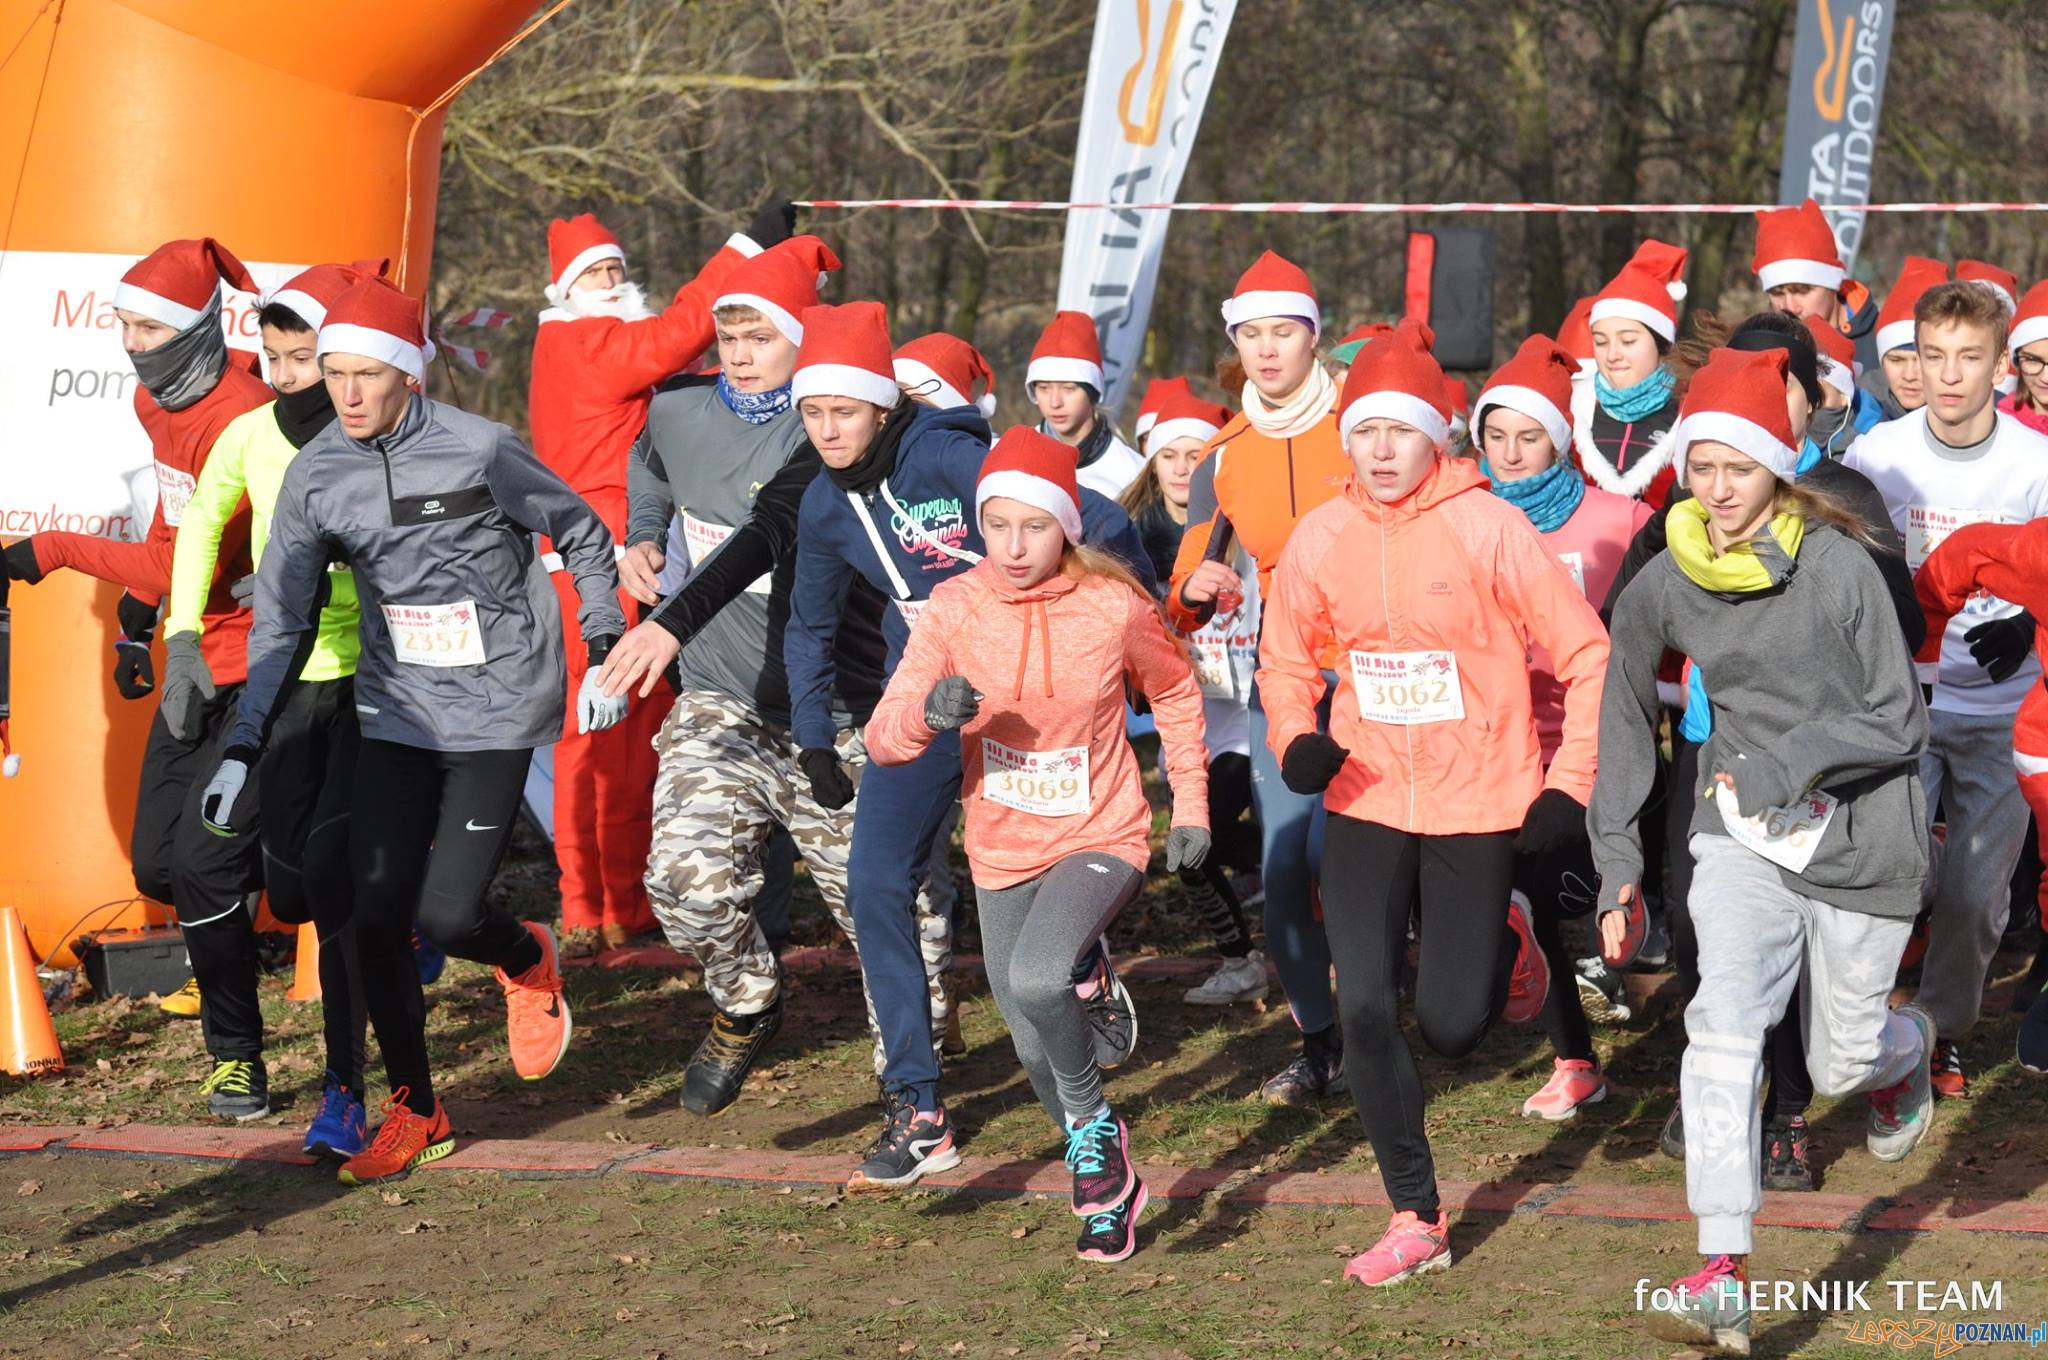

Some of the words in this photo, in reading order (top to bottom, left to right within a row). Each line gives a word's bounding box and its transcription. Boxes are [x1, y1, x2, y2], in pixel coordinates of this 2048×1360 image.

[402, 627, 470, 651] 2357
[1370, 677, 1451, 706] 3062
[999, 770, 1079, 801] 3069
